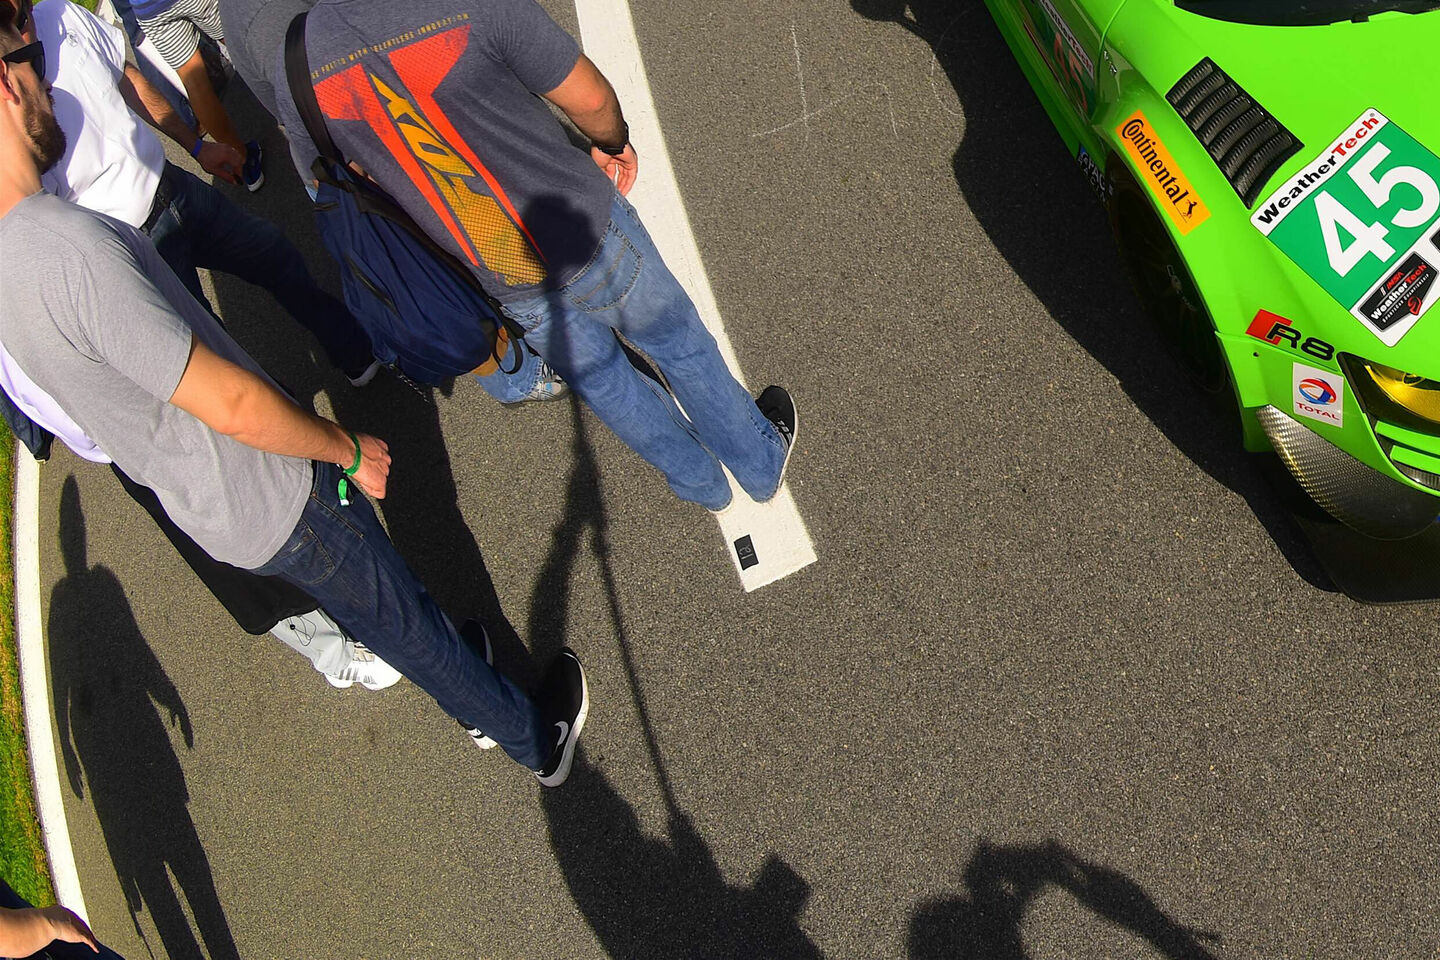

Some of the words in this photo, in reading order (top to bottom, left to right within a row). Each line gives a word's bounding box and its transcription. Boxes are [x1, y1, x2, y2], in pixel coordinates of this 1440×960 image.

[1121, 118, 1189, 206] Continental
[1257, 115, 1379, 226] WeatherTech
[1371, 264, 1428, 320] WeatherTech
[1266, 321, 1335, 362] R8
[1295, 402, 1340, 421] TOTAL
